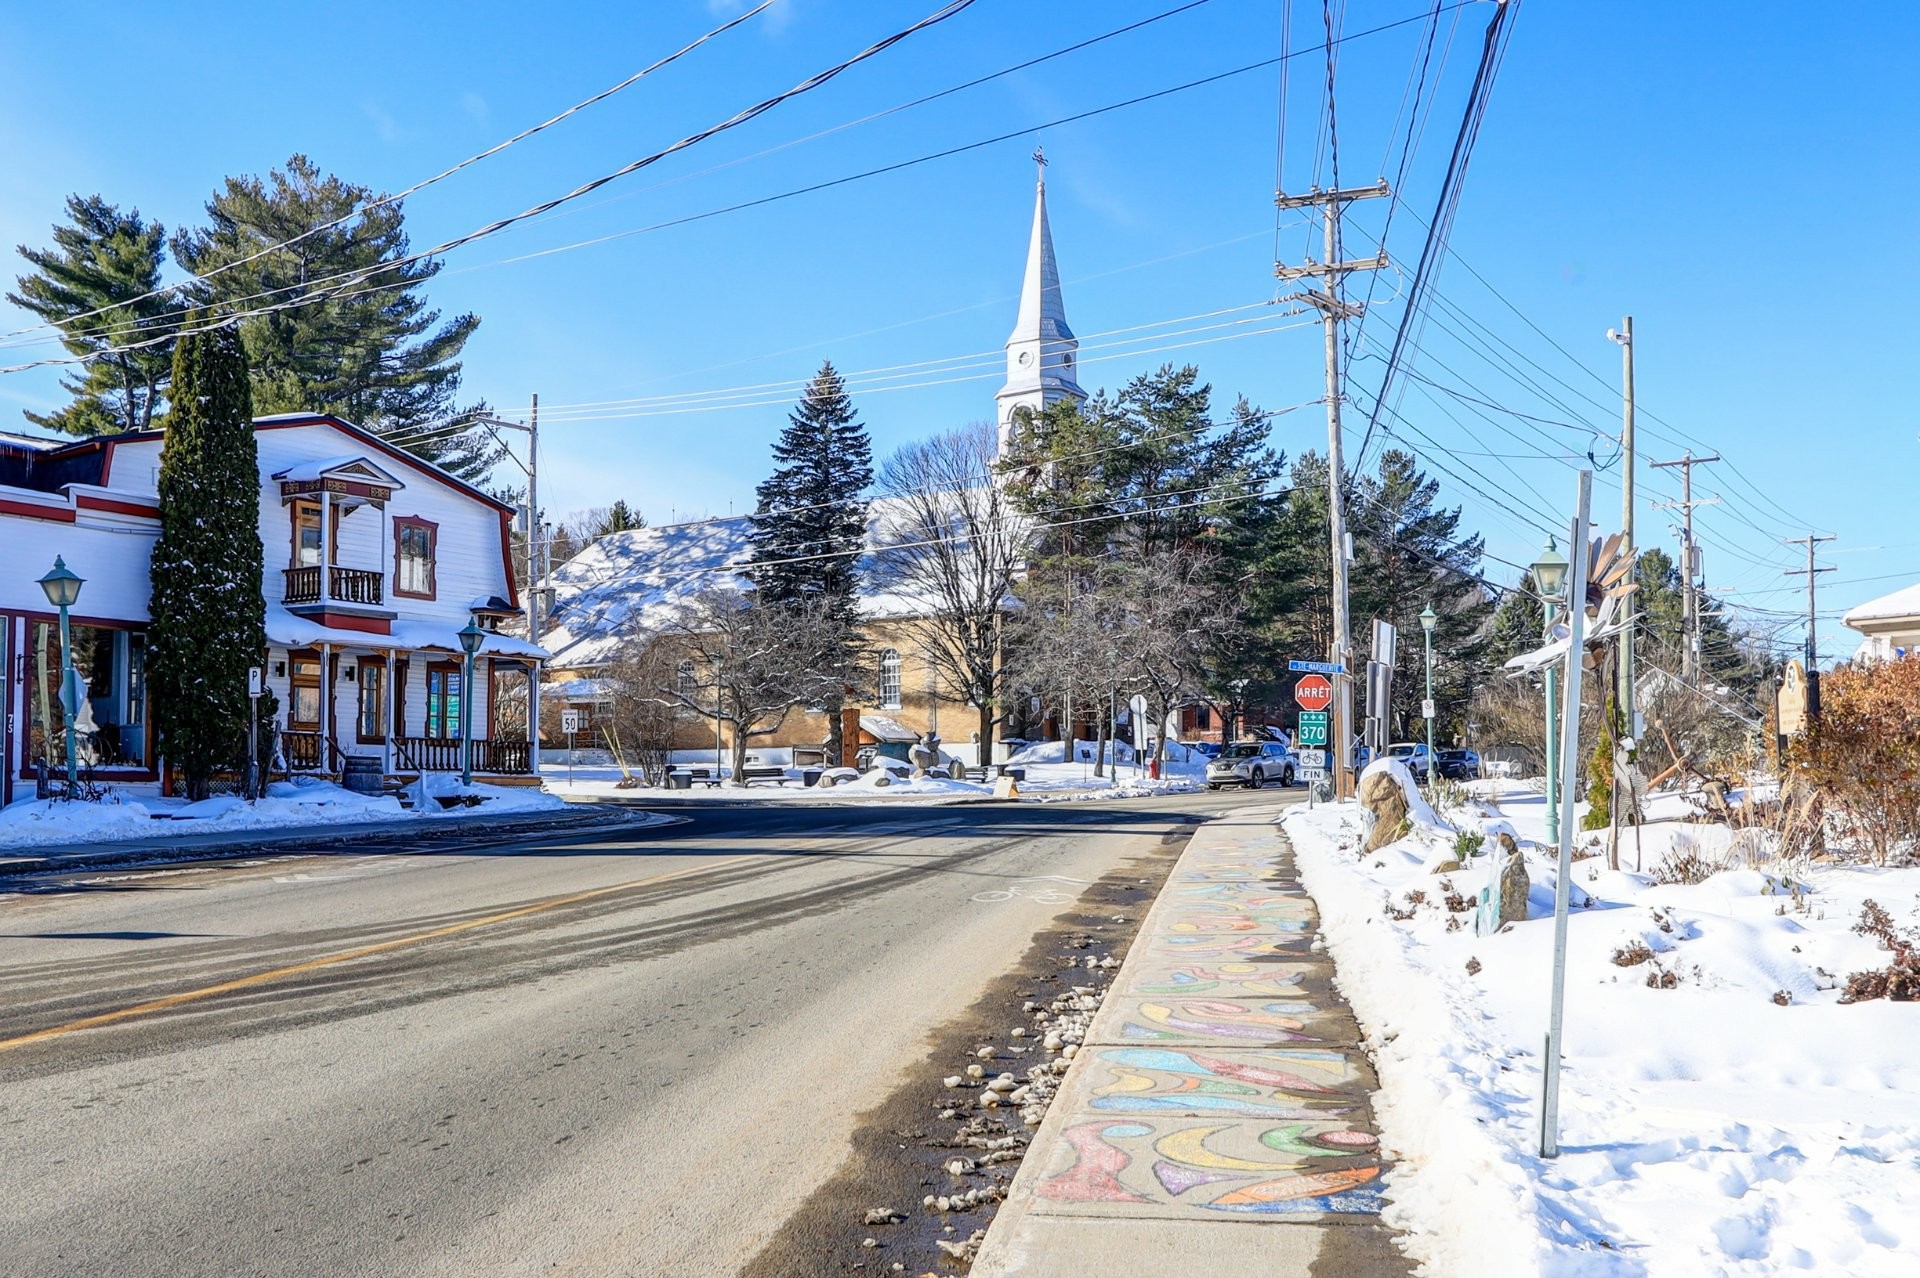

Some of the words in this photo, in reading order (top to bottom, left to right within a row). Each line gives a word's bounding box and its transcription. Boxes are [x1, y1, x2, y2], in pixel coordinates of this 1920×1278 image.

[252, 670, 258, 681] P
[1297, 686, 1330, 698] ARRÊT
[565, 717, 576, 730] 50
[1301, 726, 1325, 740] 370
[1303, 770, 1321, 779] FIN
